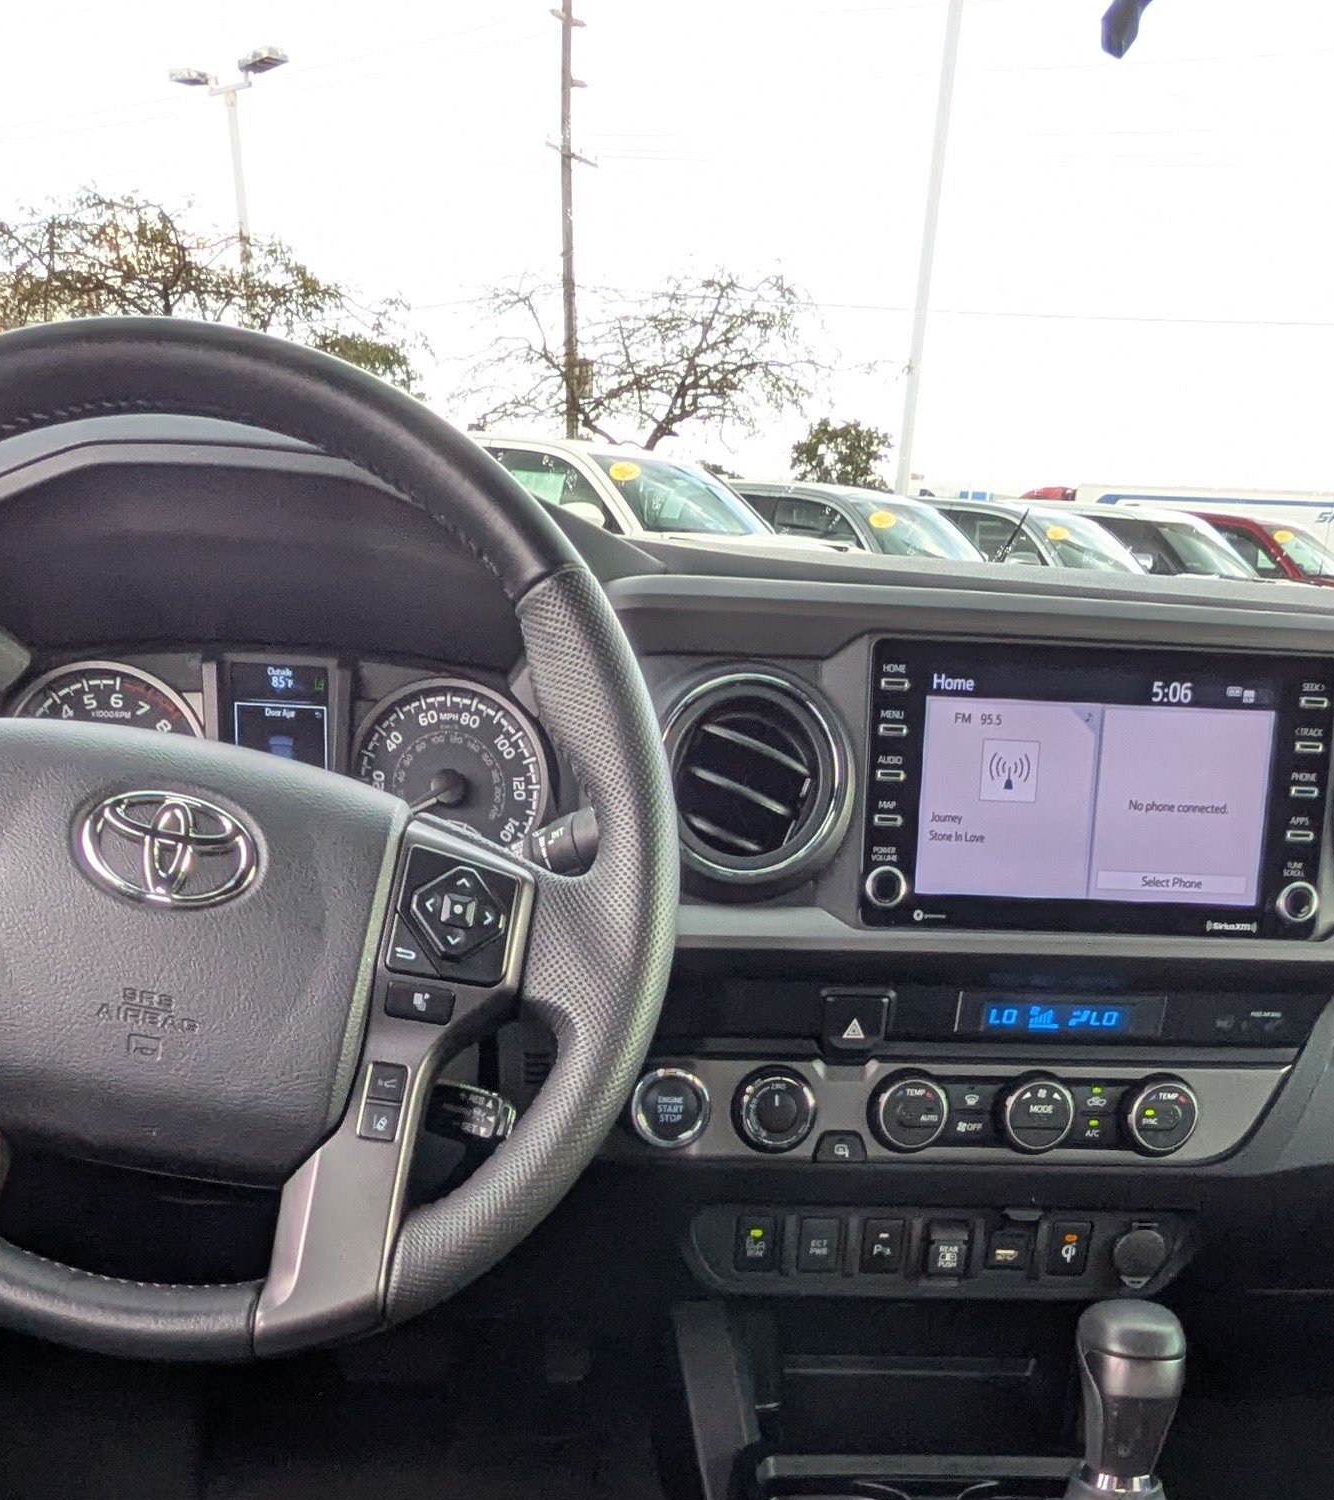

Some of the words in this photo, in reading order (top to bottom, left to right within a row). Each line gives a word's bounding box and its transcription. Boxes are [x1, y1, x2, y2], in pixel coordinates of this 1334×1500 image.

[882, 664, 906, 674] HOME
[932, 673, 975, 691] Home
[1151, 681, 1192, 703] 5:06
[83, 693, 97, 710] 5
[110, 693, 124, 708] 6
[62, 704, 75, 719] 4
[136, 700, 151, 716] 7
[880, 710, 905, 720] MENU
[418, 710, 437, 726] 60
[439, 713, 459, 721] MPH
[459, 712, 480, 729] 80
[954, 712, 972, 724] FM
[980, 713, 1003, 726] 95.5
[155, 718, 172, 733] 8
[386, 731, 403, 752] 40
[494, 734, 515, 760] 100
[877, 755, 903, 765] AUDIO
[1291, 772, 1317, 782] PHONE
[512, 776, 526, 801] 120
[878, 800, 897, 810] MAP
[1128, 799, 1144, 811] No
[1145, 801, 1175, 814] phone
[1177, 802, 1229, 815] connected.
[929, 811, 963, 825] Journey
[1289, 816, 1310, 826] APPS
[500, 817, 520, 842] 140
[928, 830, 953, 842] Stone
[954, 831, 963, 842] In
[965, 832, 986, 844] Love
[1141, 876, 1170, 888] Select
[1172, 877, 1203, 889] Phone
[122, 987, 173, 1006] SRS
[988, 1008, 1018, 1025] LO
[905, 1088, 925, 1096] TEMP
[1158, 1092, 1179, 1100] TEMP
[657, 1095, 684, 1104] ENGINE
[657, 1104, 684, 1113] START
[1029, 1104, 1055, 1114] MODE
[659, 1114, 682, 1123] STOP
[920, 1114, 938, 1122] AUTO
[967, 1123, 983, 1131] OFF
[1085, 1129, 1101, 1138] A/C
